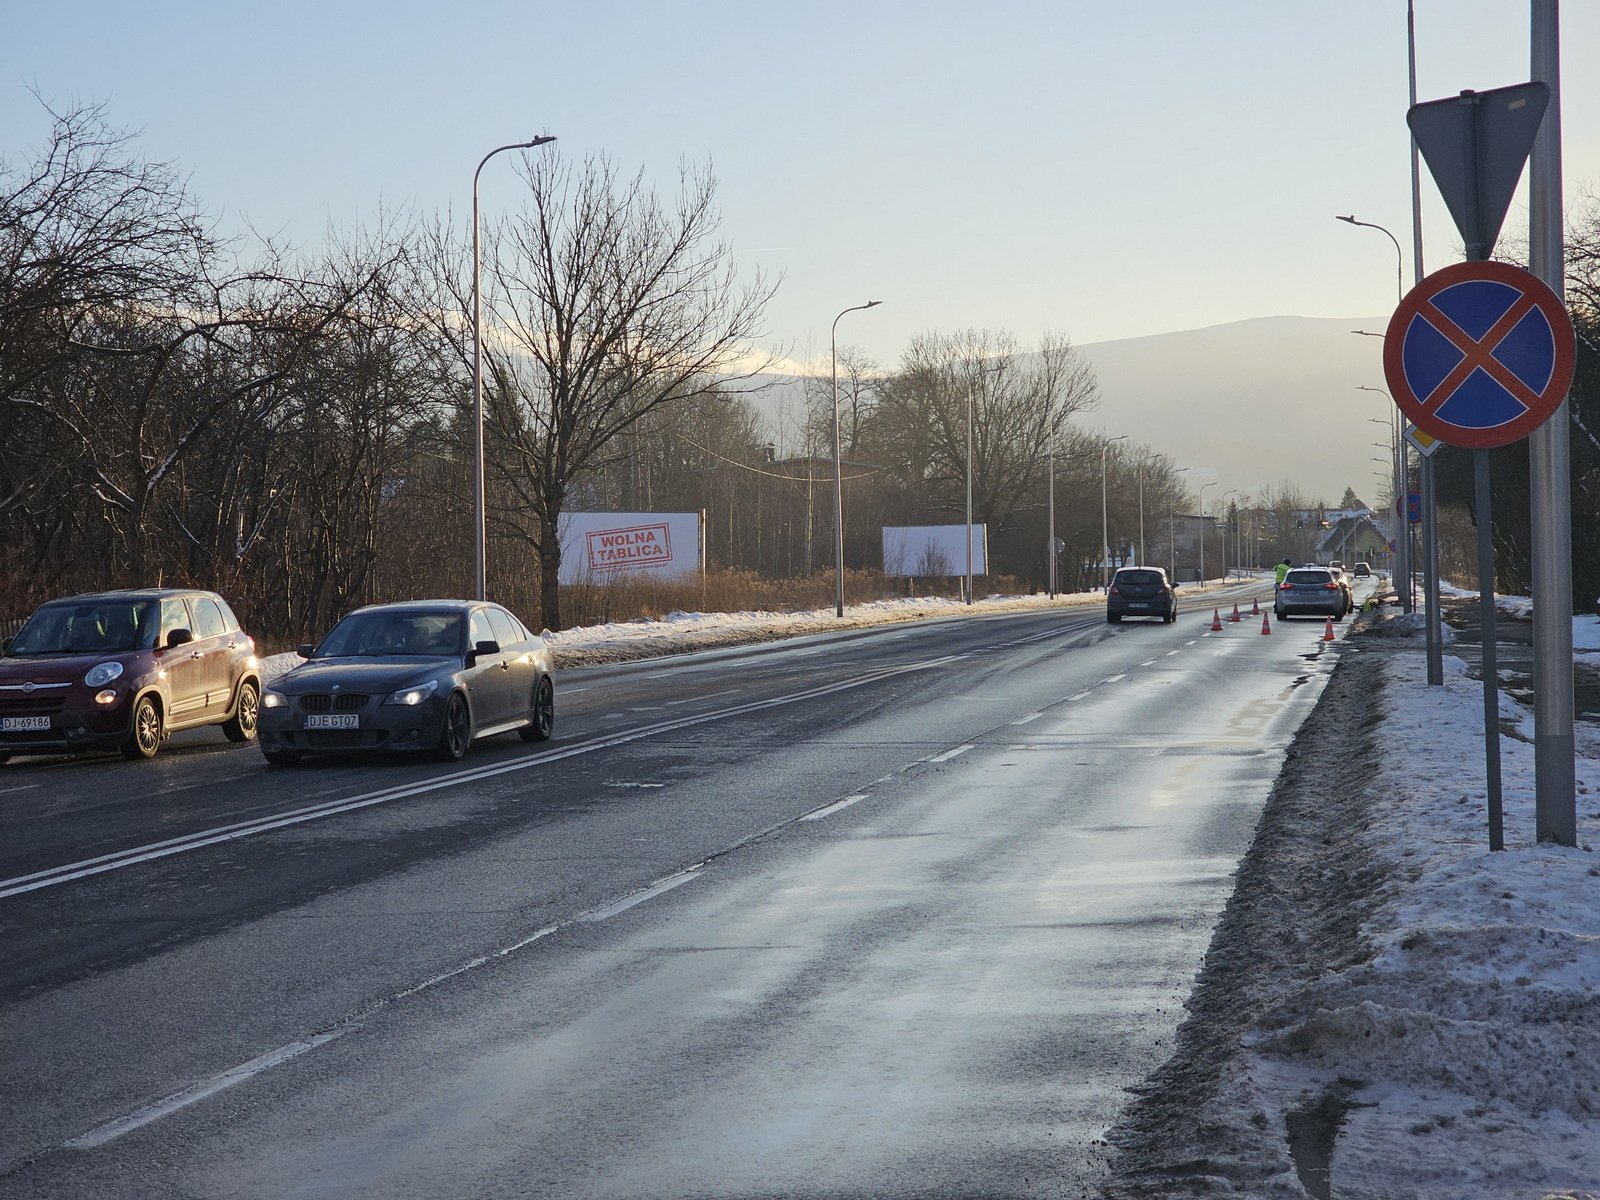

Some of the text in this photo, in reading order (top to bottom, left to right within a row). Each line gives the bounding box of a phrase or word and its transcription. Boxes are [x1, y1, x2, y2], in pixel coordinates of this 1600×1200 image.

[601, 531, 656, 548] WOLNA
[598, 544, 663, 560] TABLICA
[20, 717, 49, 728] 69186
[309, 715, 356, 727] DJE GT07
